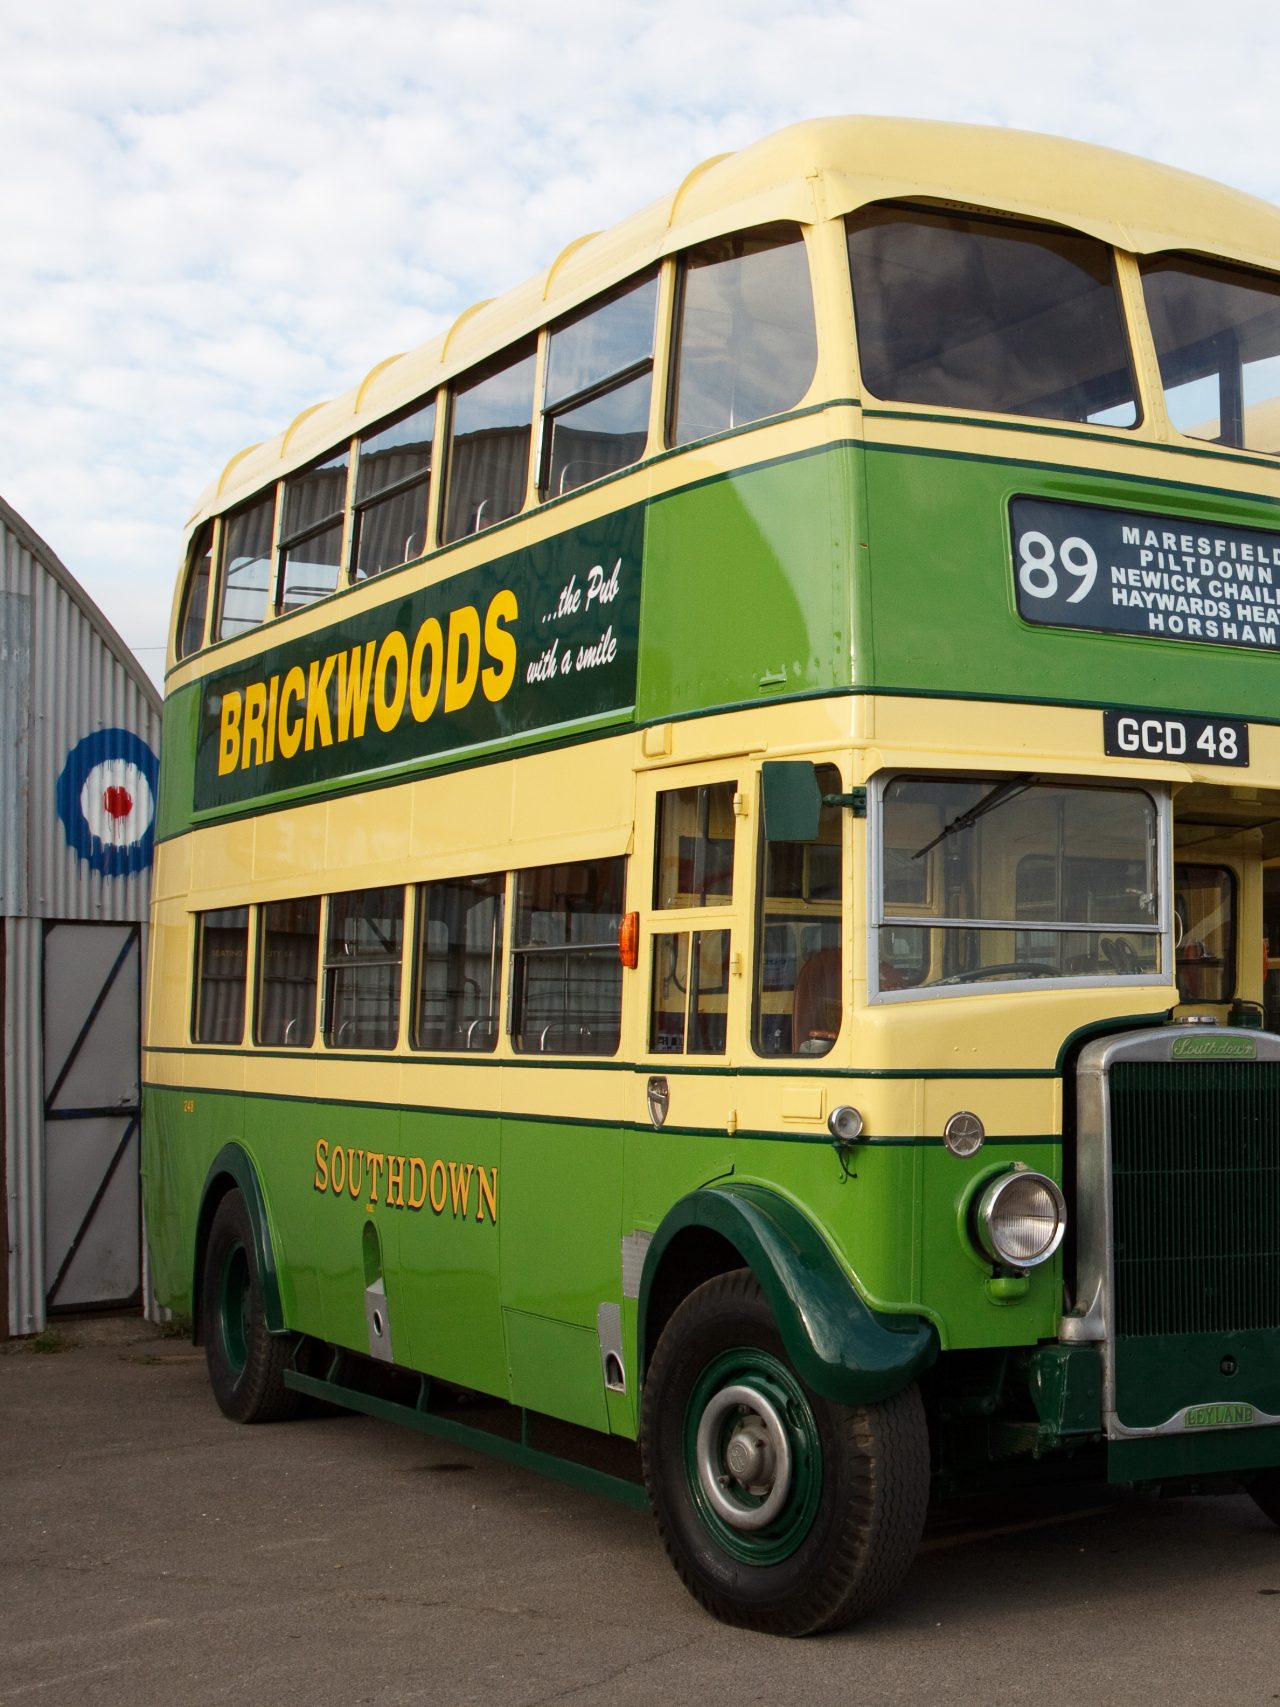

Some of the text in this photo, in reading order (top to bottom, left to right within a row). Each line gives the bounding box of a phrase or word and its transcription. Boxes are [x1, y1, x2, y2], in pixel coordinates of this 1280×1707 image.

[586, 557, 622, 612] Pub
[1018, 531, 1098, 604] 89
[1110, 566, 1201, 595] NEWICK
[1139, 550, 1273, 584] PILTDOWN
[1112, 587, 1231, 619] HAYWARDS
[1148, 613, 1277, 645] HORSHAM
[526, 625, 617, 684] with a smile
[218, 589, 519, 777] BRICKWOODS
[1117, 717, 1238, 760] GCD 48
[1173, 1038, 1254, 1056] Southdown
[313, 1138, 499, 1223] SOUTHDOWN
[1187, 1405, 1254, 1426] LEYLAND
